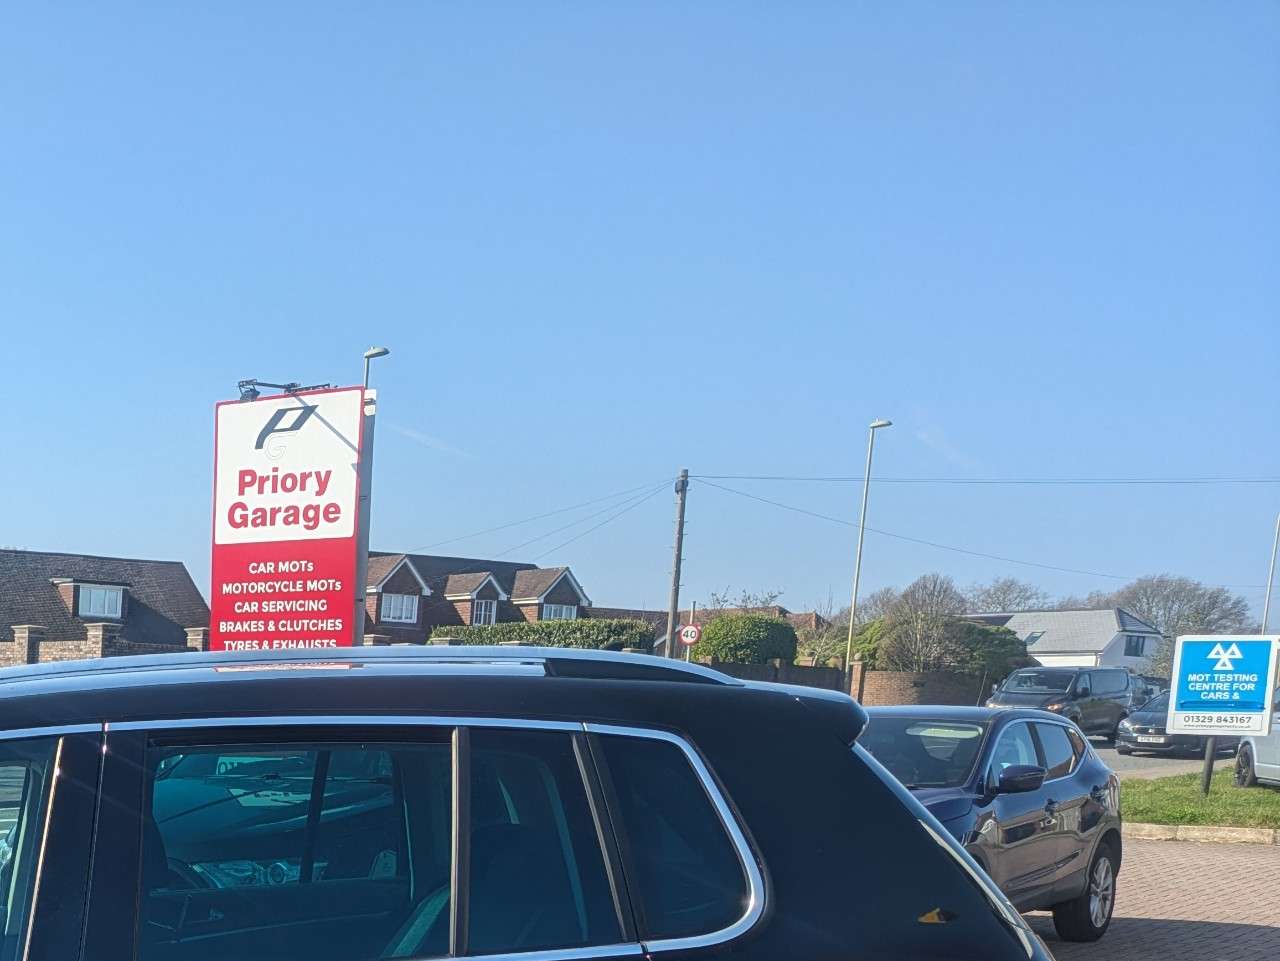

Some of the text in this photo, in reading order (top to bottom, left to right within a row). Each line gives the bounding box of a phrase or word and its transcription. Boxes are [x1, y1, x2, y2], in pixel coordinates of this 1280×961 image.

[237, 467, 332, 497] Priory
[227, 501, 341, 531] Garage
[248, 560, 314, 574] CAR MOTs
[222, 579, 342, 594] MOTORCYCLE MOTs
[234, 600, 328, 614] CAR SERVICING
[219, 619, 343, 633] BRAKES & CLUTCHES
[683, 630, 697, 639] 40
[223, 639, 337, 652] TYRES & EXHAUSTS
[1187, 674, 1258, 682] MOT TESTING
[1200, 692, 1240, 700] CARS &
[1183, 715, 1252, 724] 01329 843167
